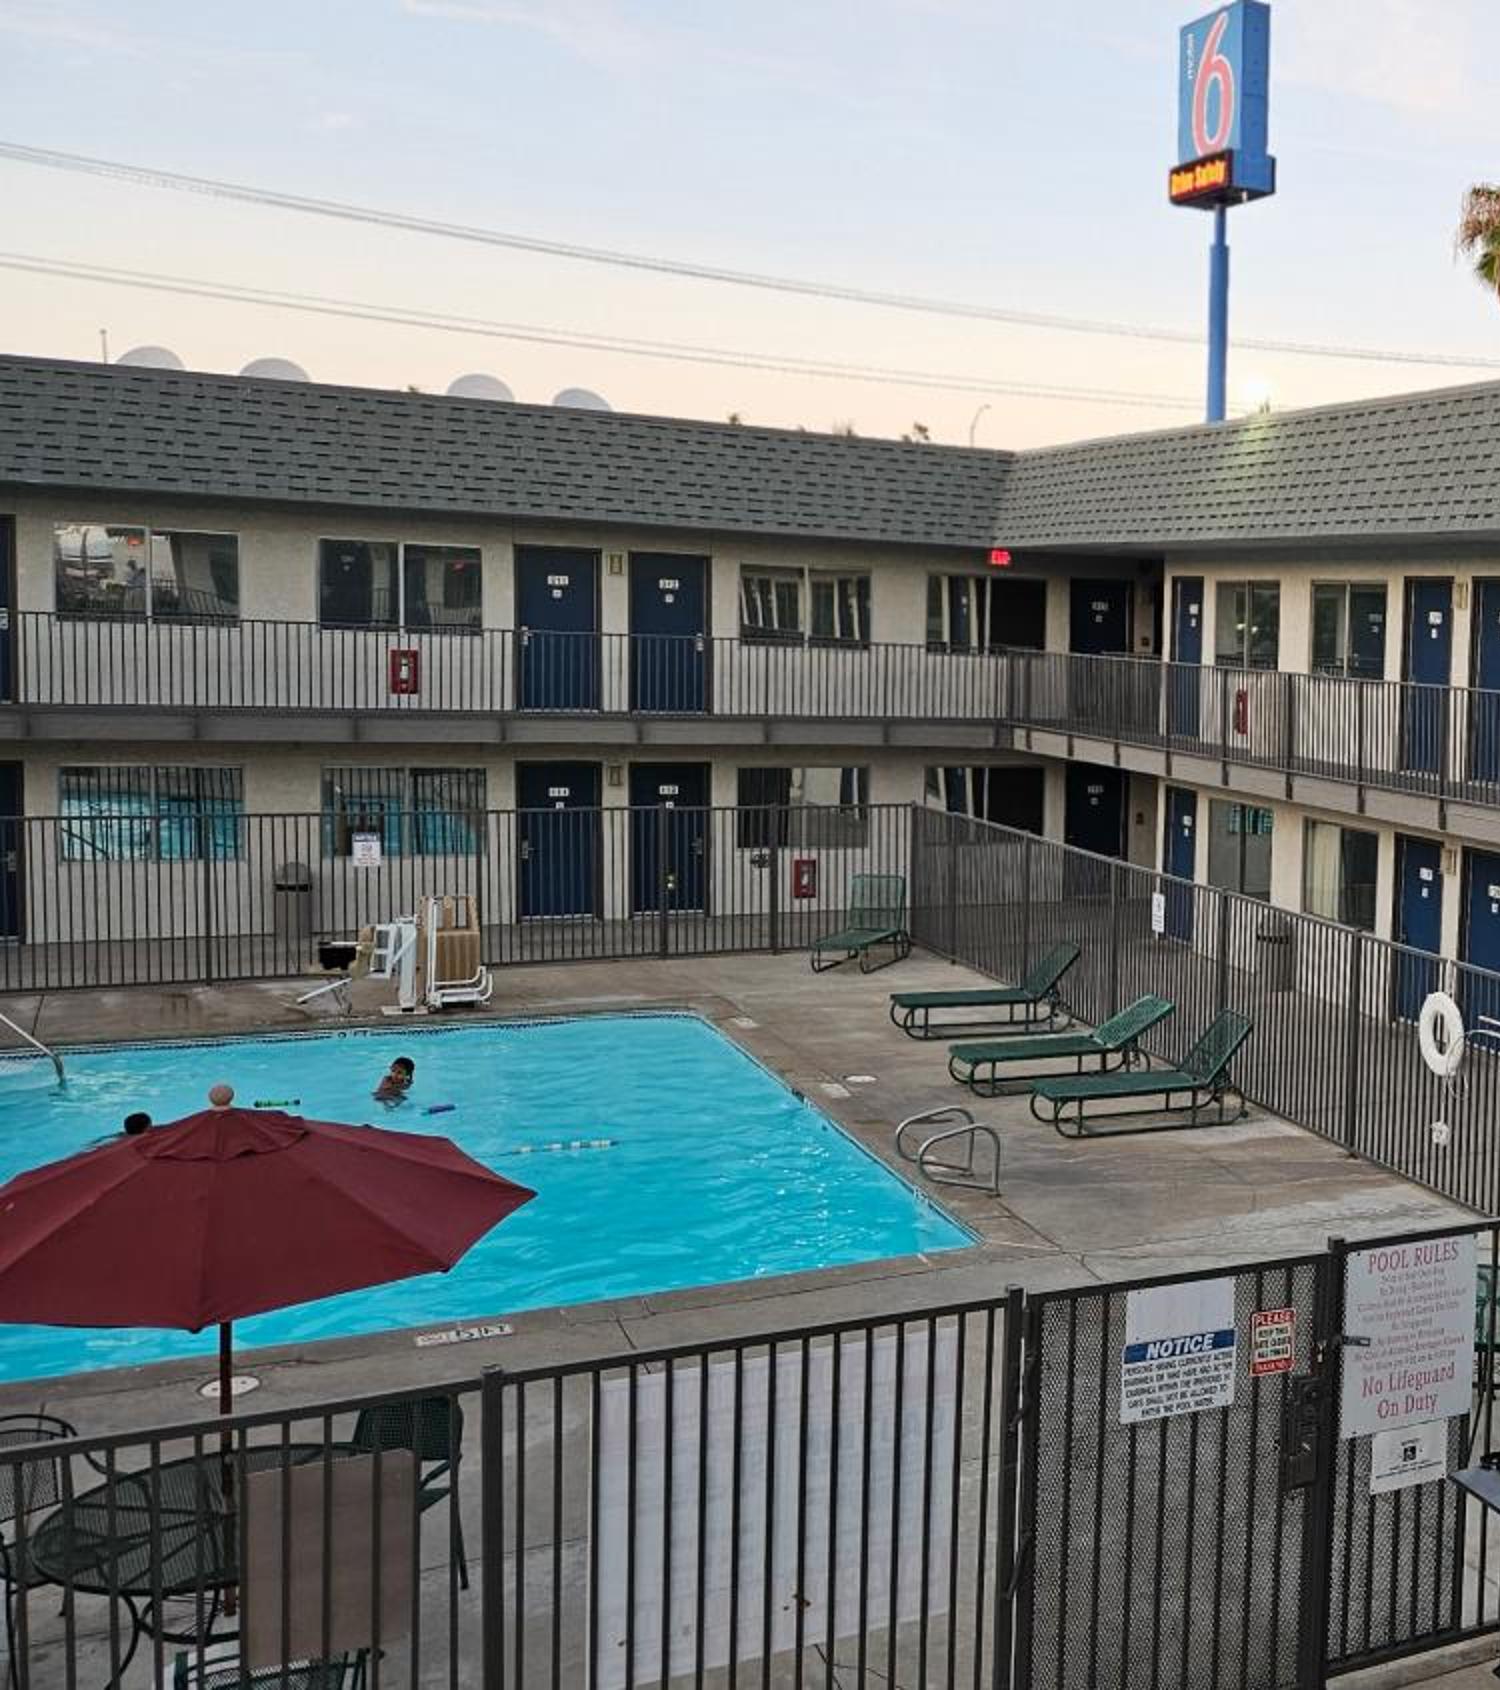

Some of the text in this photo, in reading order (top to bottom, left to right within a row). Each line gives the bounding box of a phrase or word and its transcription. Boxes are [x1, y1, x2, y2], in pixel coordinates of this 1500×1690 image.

[1192, 11, 1234, 157] 6
[1368, 1249, 1408, 1274] POOL
[1414, 1241, 1459, 1267] RULES
[1257, 1311, 1292, 1325] PLEASE
[1146, 1334, 1214, 1359] NOTICE
[1362, 1361, 1455, 1398] No Lifeguard
[1378, 1393, 1438, 1418] On Duty
